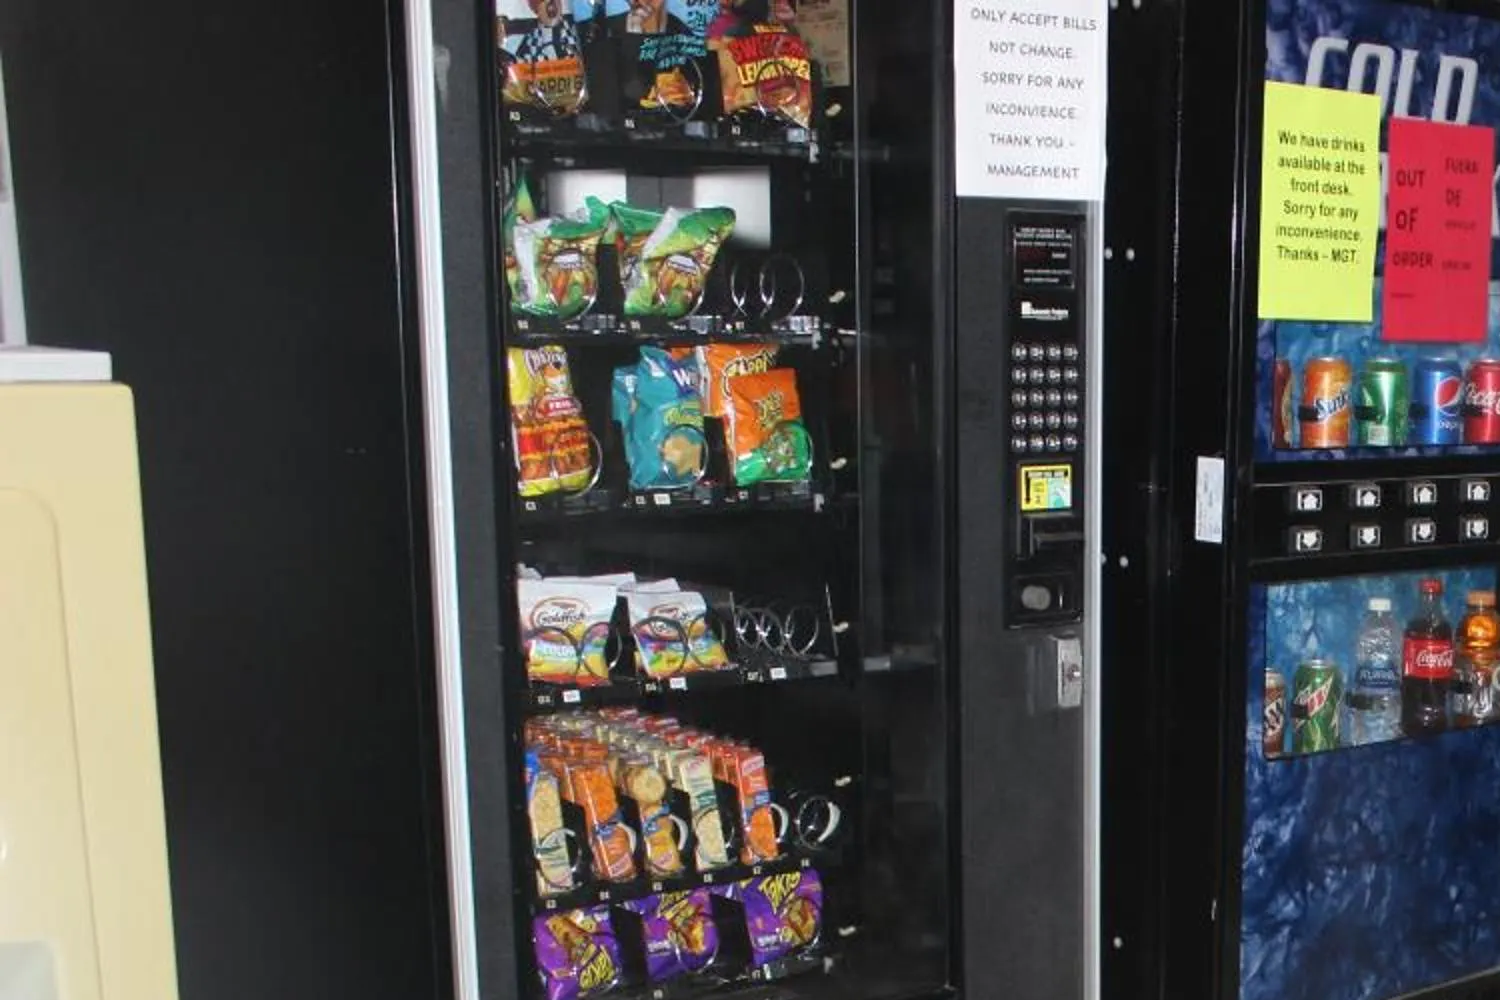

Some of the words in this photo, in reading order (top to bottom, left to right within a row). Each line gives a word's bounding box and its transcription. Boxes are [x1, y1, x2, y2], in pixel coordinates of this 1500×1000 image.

[970, 7, 1006, 22] ONLY
[1009, 12, 1059, 27] ACCEPT
[1063, 16, 1098, 31] BILLS
[989, 40, 1016, 53] NOT
[981, 71, 1024, 86] SORRY
[1027, 75, 1053, 89] FOR
[1057, 77, 1085, 91] ANY
[1304, 36, 1478, 126] COLD
[989, 132, 1031, 147] THANK
[1278, 129, 1297, 146] We
[1300, 132, 1329, 149] have
[1331, 136, 1365, 153] drinks
[986, 163, 1080, 180] MANAGEMENT
[1278, 155, 1331, 173] available
[1334, 159, 1345, 174] at
[1347, 160, 1366, 175] the
[1290, 177, 1319, 194] front
[1322, 180, 1354, 196] desk.
[1395, 168, 1425, 188] OUT
[1446, 188, 1461, 207] DE
[1283, 200, 1316, 219] Sorry
[1319, 202, 1337, 217] for
[1338, 206, 1359, 222] any
[1395, 206, 1418, 233] OF
[1277, 244, 1319, 262] Thanks
[1332, 248, 1360, 264] MGT.
[1392, 252, 1433, 268] ORDER
[538, 609, 587, 627] Goldfish
